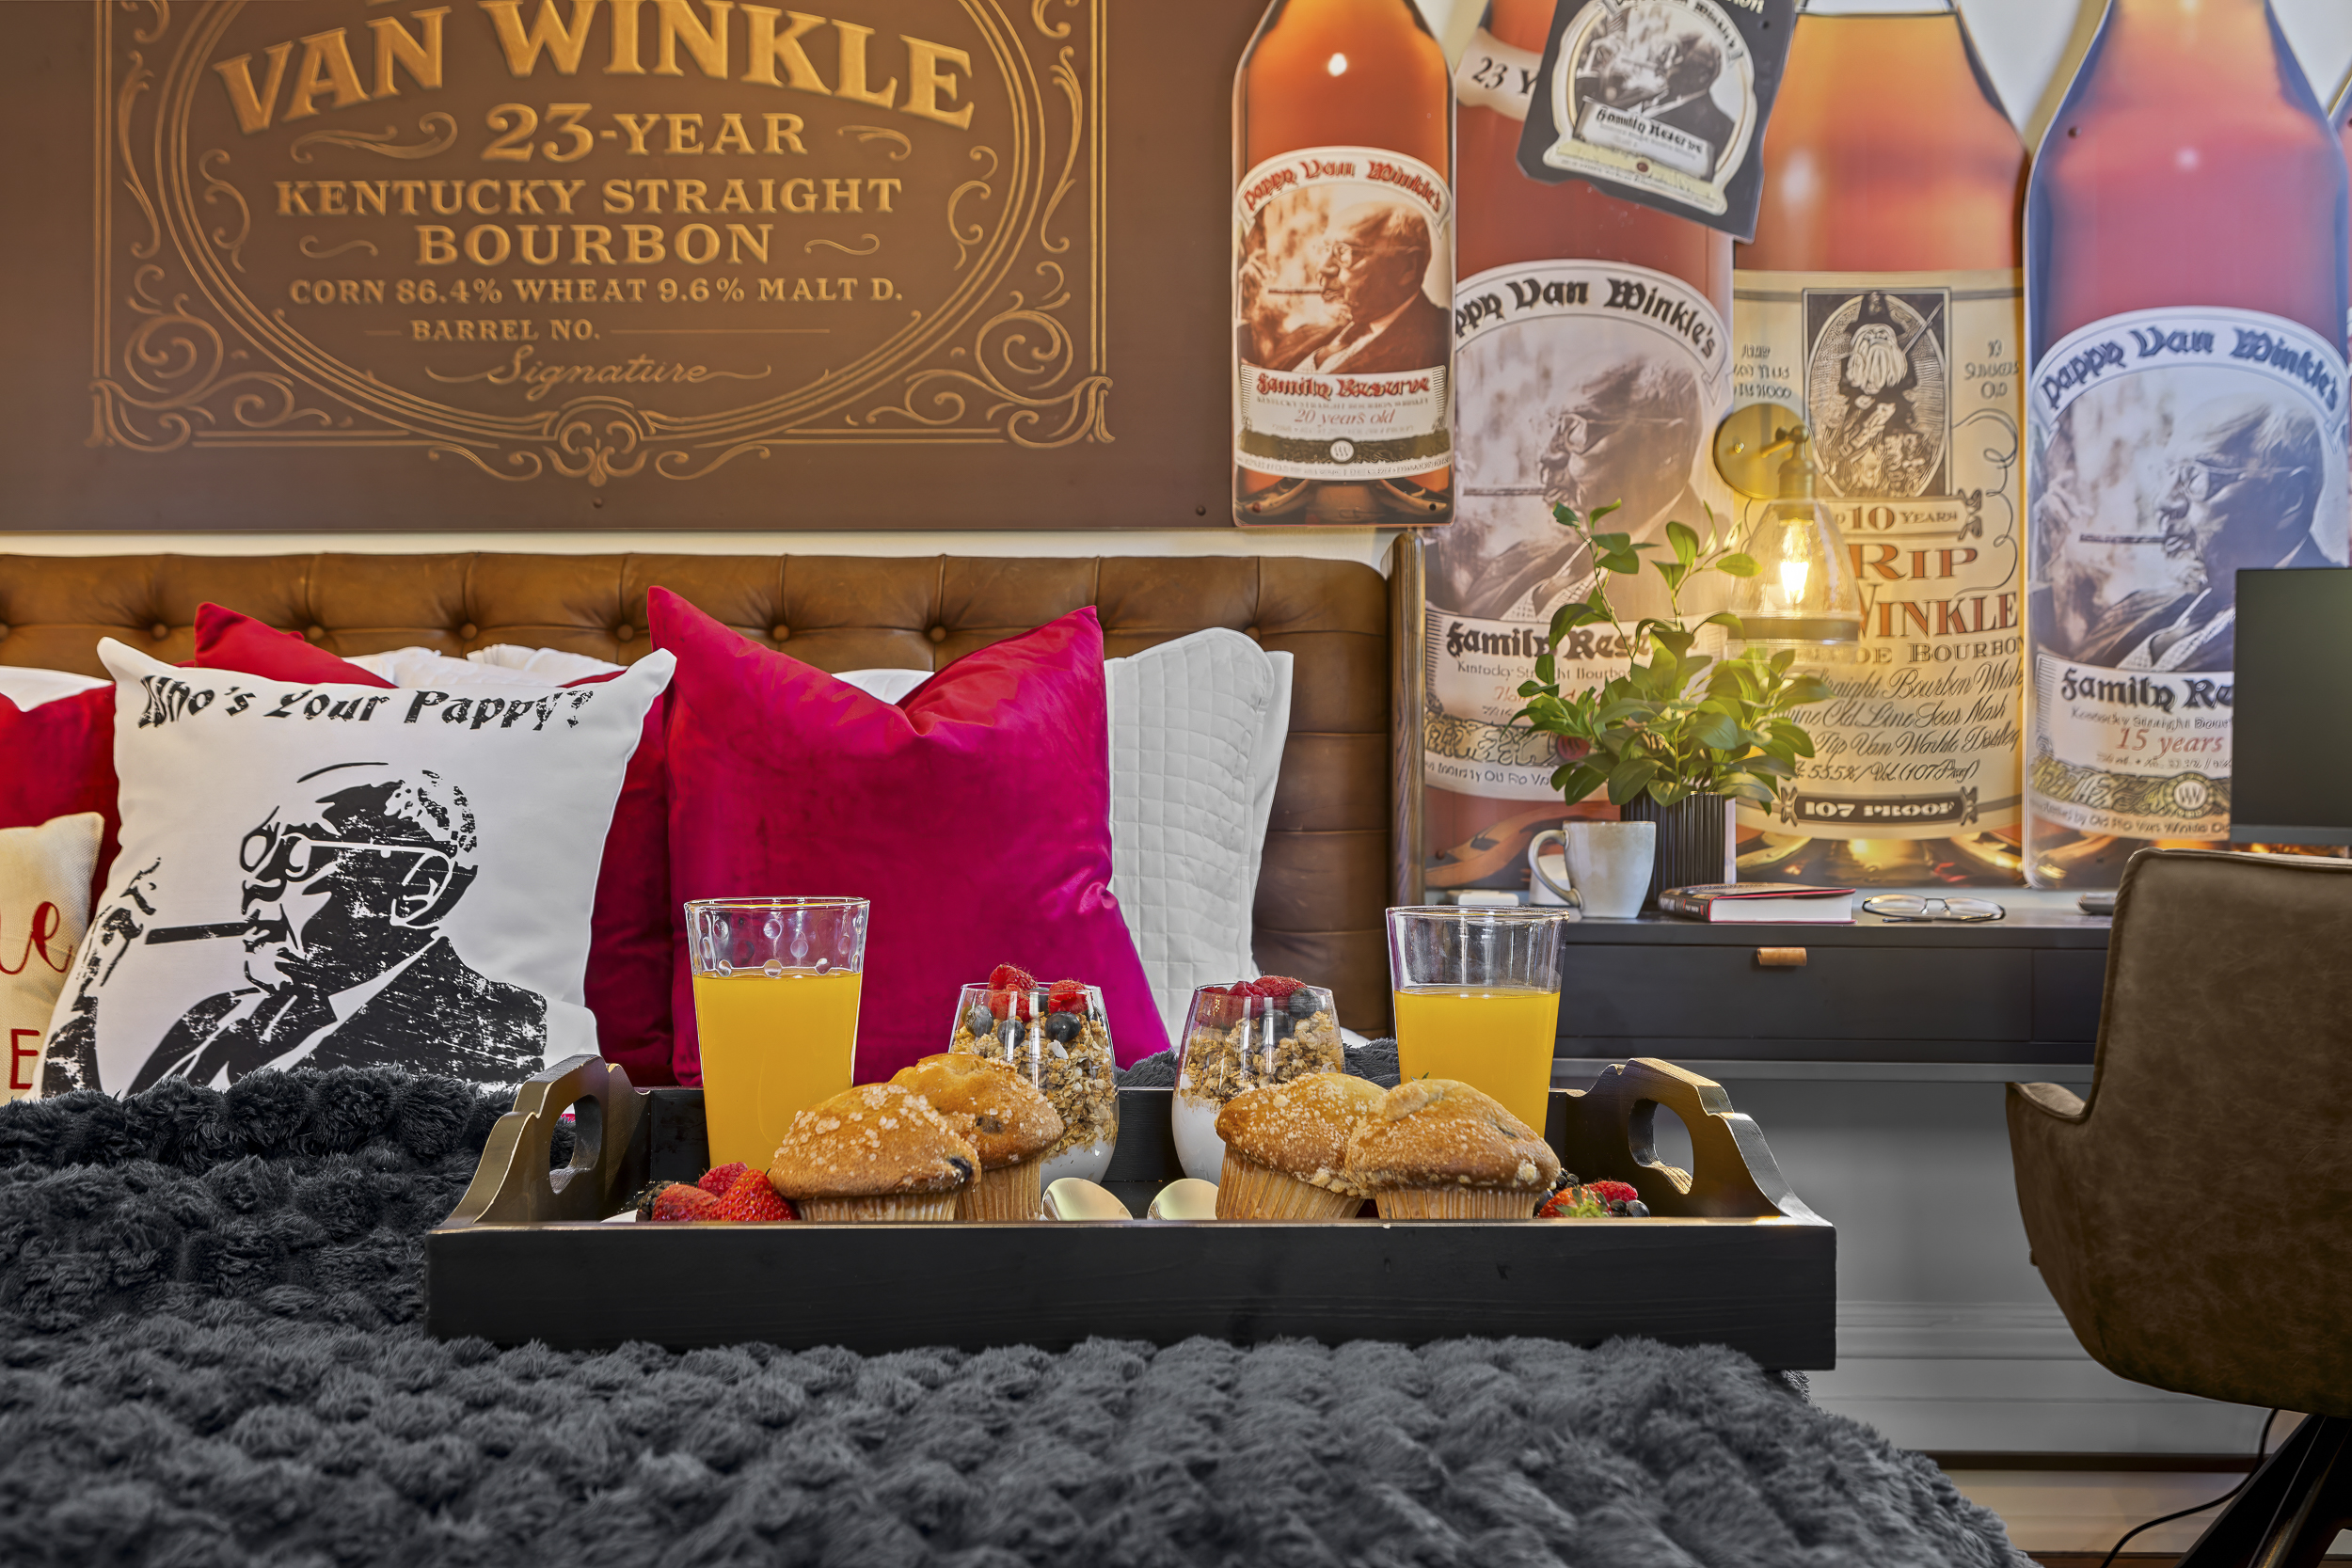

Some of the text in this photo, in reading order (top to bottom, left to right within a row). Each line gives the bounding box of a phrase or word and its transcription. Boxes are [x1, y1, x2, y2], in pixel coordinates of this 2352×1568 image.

[213, 0, 976, 136] VAN WINKLE
[1471, 55, 1509, 91] 23
[479, 103, 809, 164] 23-YEAR
[1298, 159, 1356, 180] Van
[275, 177, 903, 217] KENTUCKY STRAIGHT
[414, 222, 774, 267] BOURBON
[289, 277, 903, 306] CORN 86.4% WHEAT 9.6% MALT D.
[410, 318, 601, 342] BARREL NO.
[1505, 277, 1590, 310] Van
[1603, 277, 1716, 360] Winkle's
[2128, 325, 2216, 357] Van
[487, 344, 709, 402] Signature
[1256, 372, 1333, 402] Family
[1294, 408, 1396, 427] 20 years old
[1847, 505, 1896, 531] 10
[1847, 543, 1979, 581] RIP
[2060, 667, 2178, 715] Family
[262, 688, 390, 722] Your
[404, 689, 595, 732] Pappy?
[2116, 727, 2225, 760] 15 years
[1804, 800, 1956, 817] 107 PROOF
